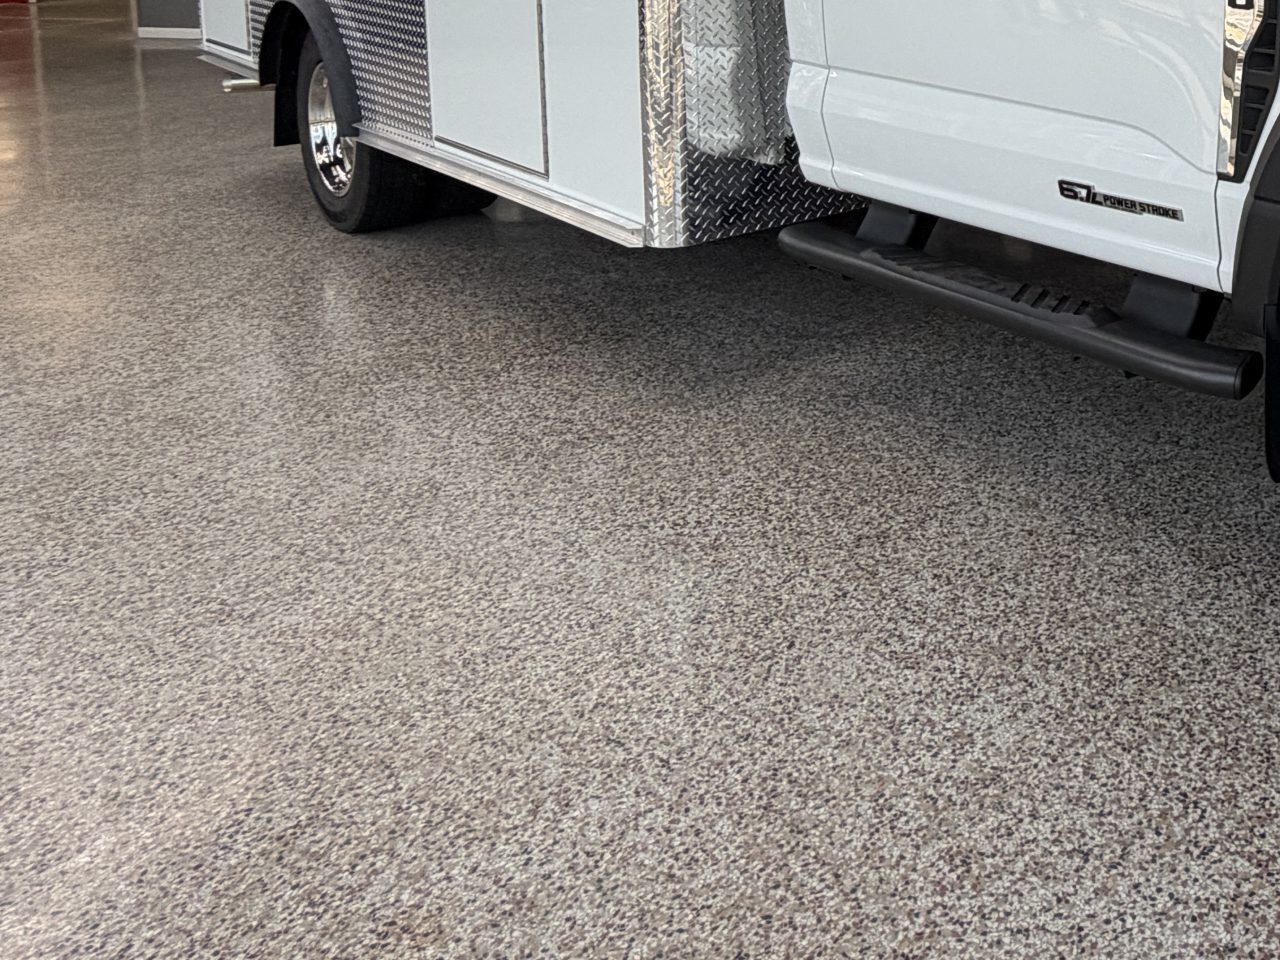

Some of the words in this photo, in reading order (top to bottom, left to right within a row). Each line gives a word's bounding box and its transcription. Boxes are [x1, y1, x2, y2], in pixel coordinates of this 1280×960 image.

[1058, 180, 1103, 206] 6.7L
[1103, 194, 1138, 211] POWER
[1139, 201, 1180, 221] STROKE
